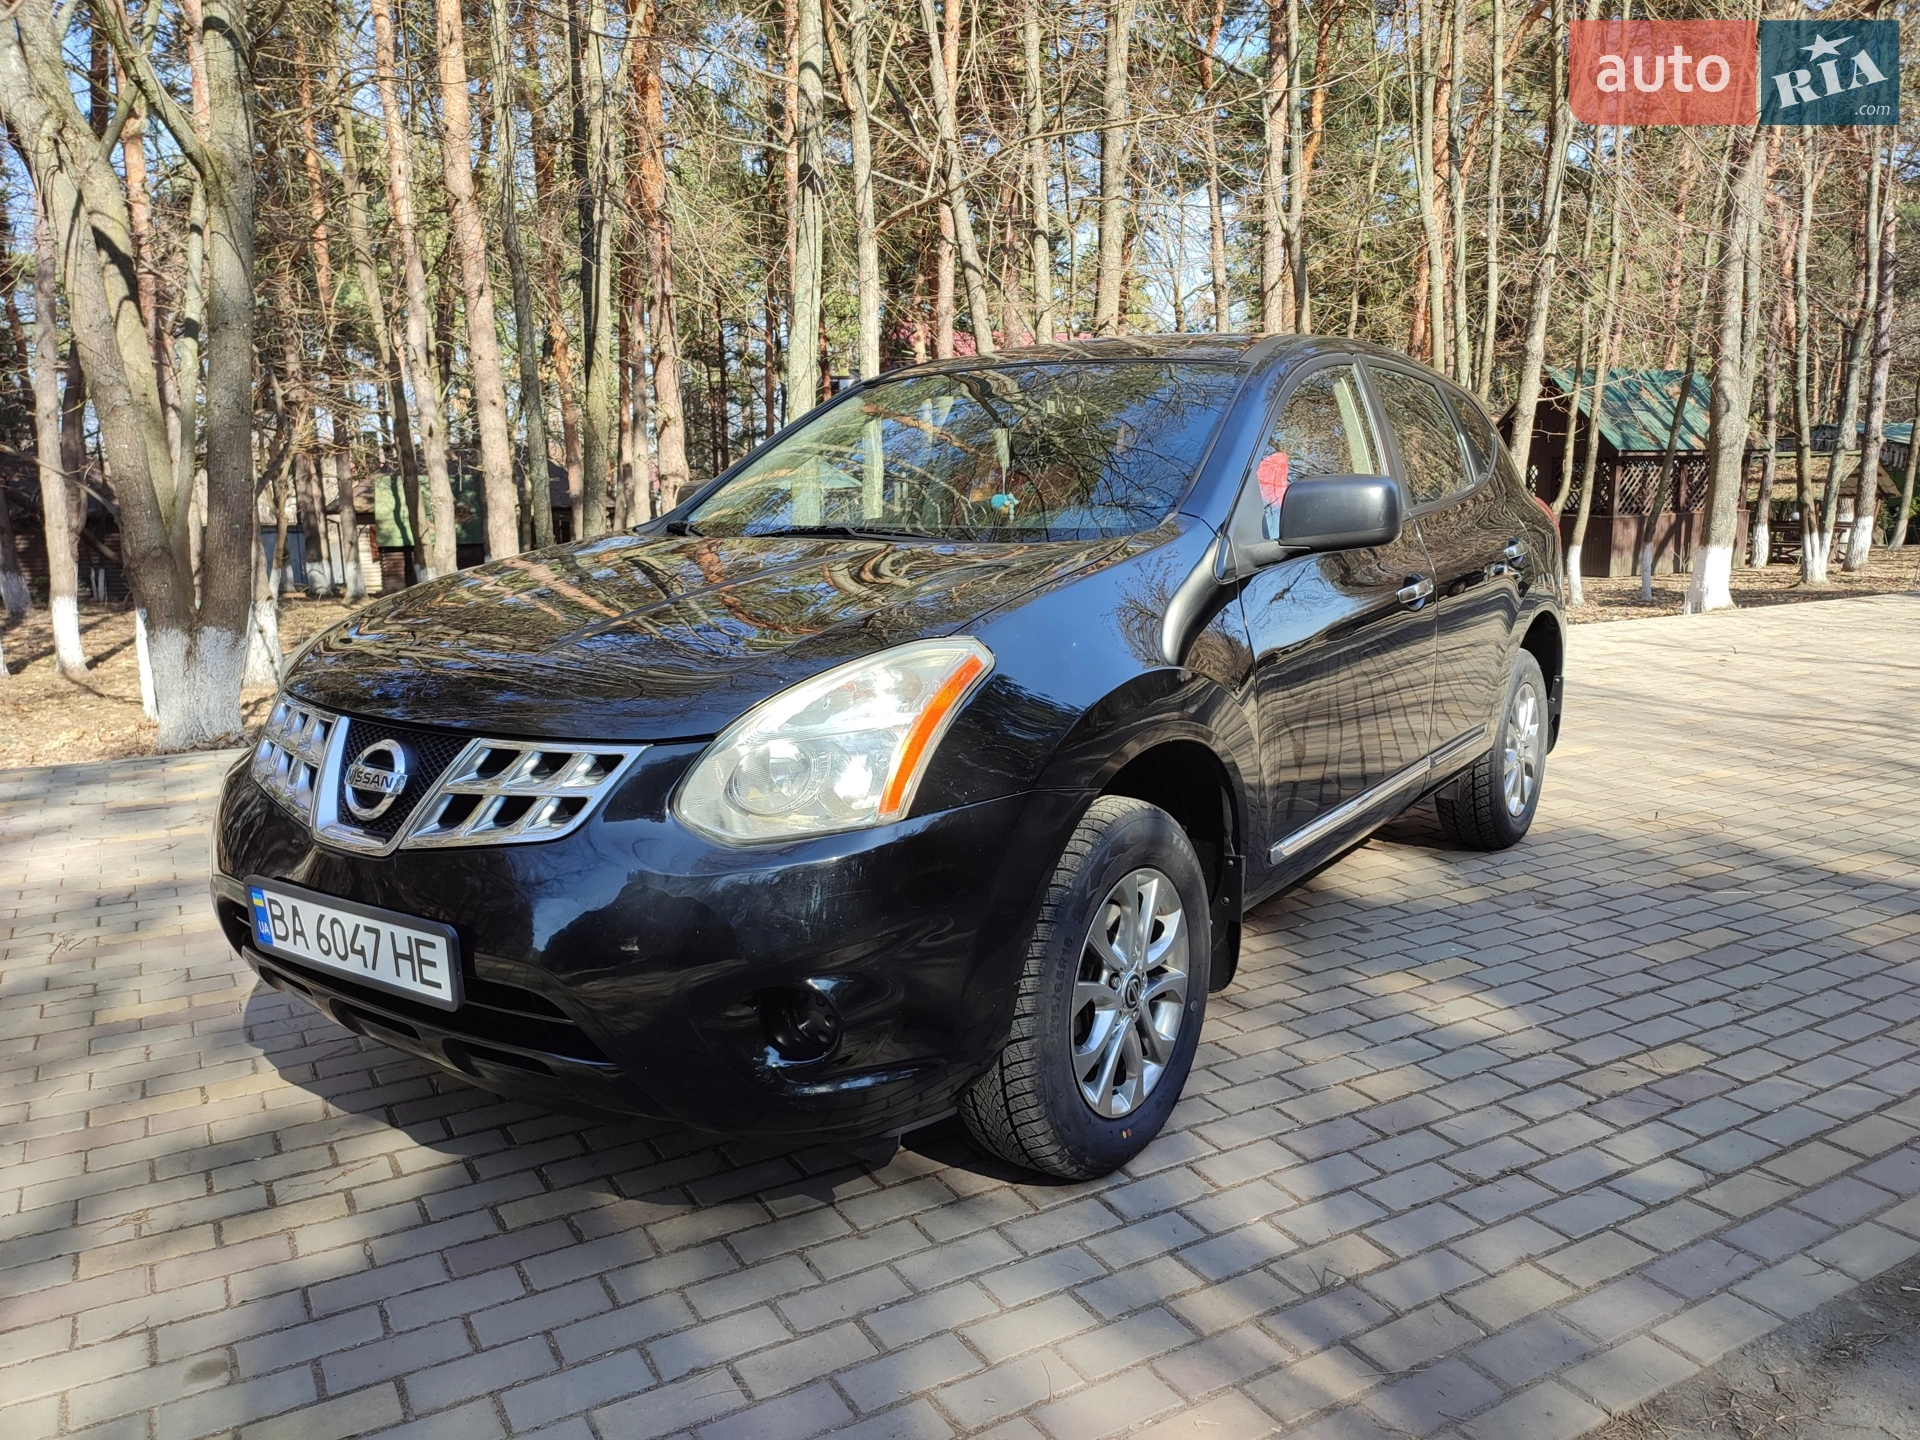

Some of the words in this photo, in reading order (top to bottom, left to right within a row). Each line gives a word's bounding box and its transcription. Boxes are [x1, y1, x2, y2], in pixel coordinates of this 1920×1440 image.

[258, 920, 271, 936] UA
[266, 897, 311, 951] BA
[316, 913, 381, 971] 6047
[390, 931, 443, 990] HE
